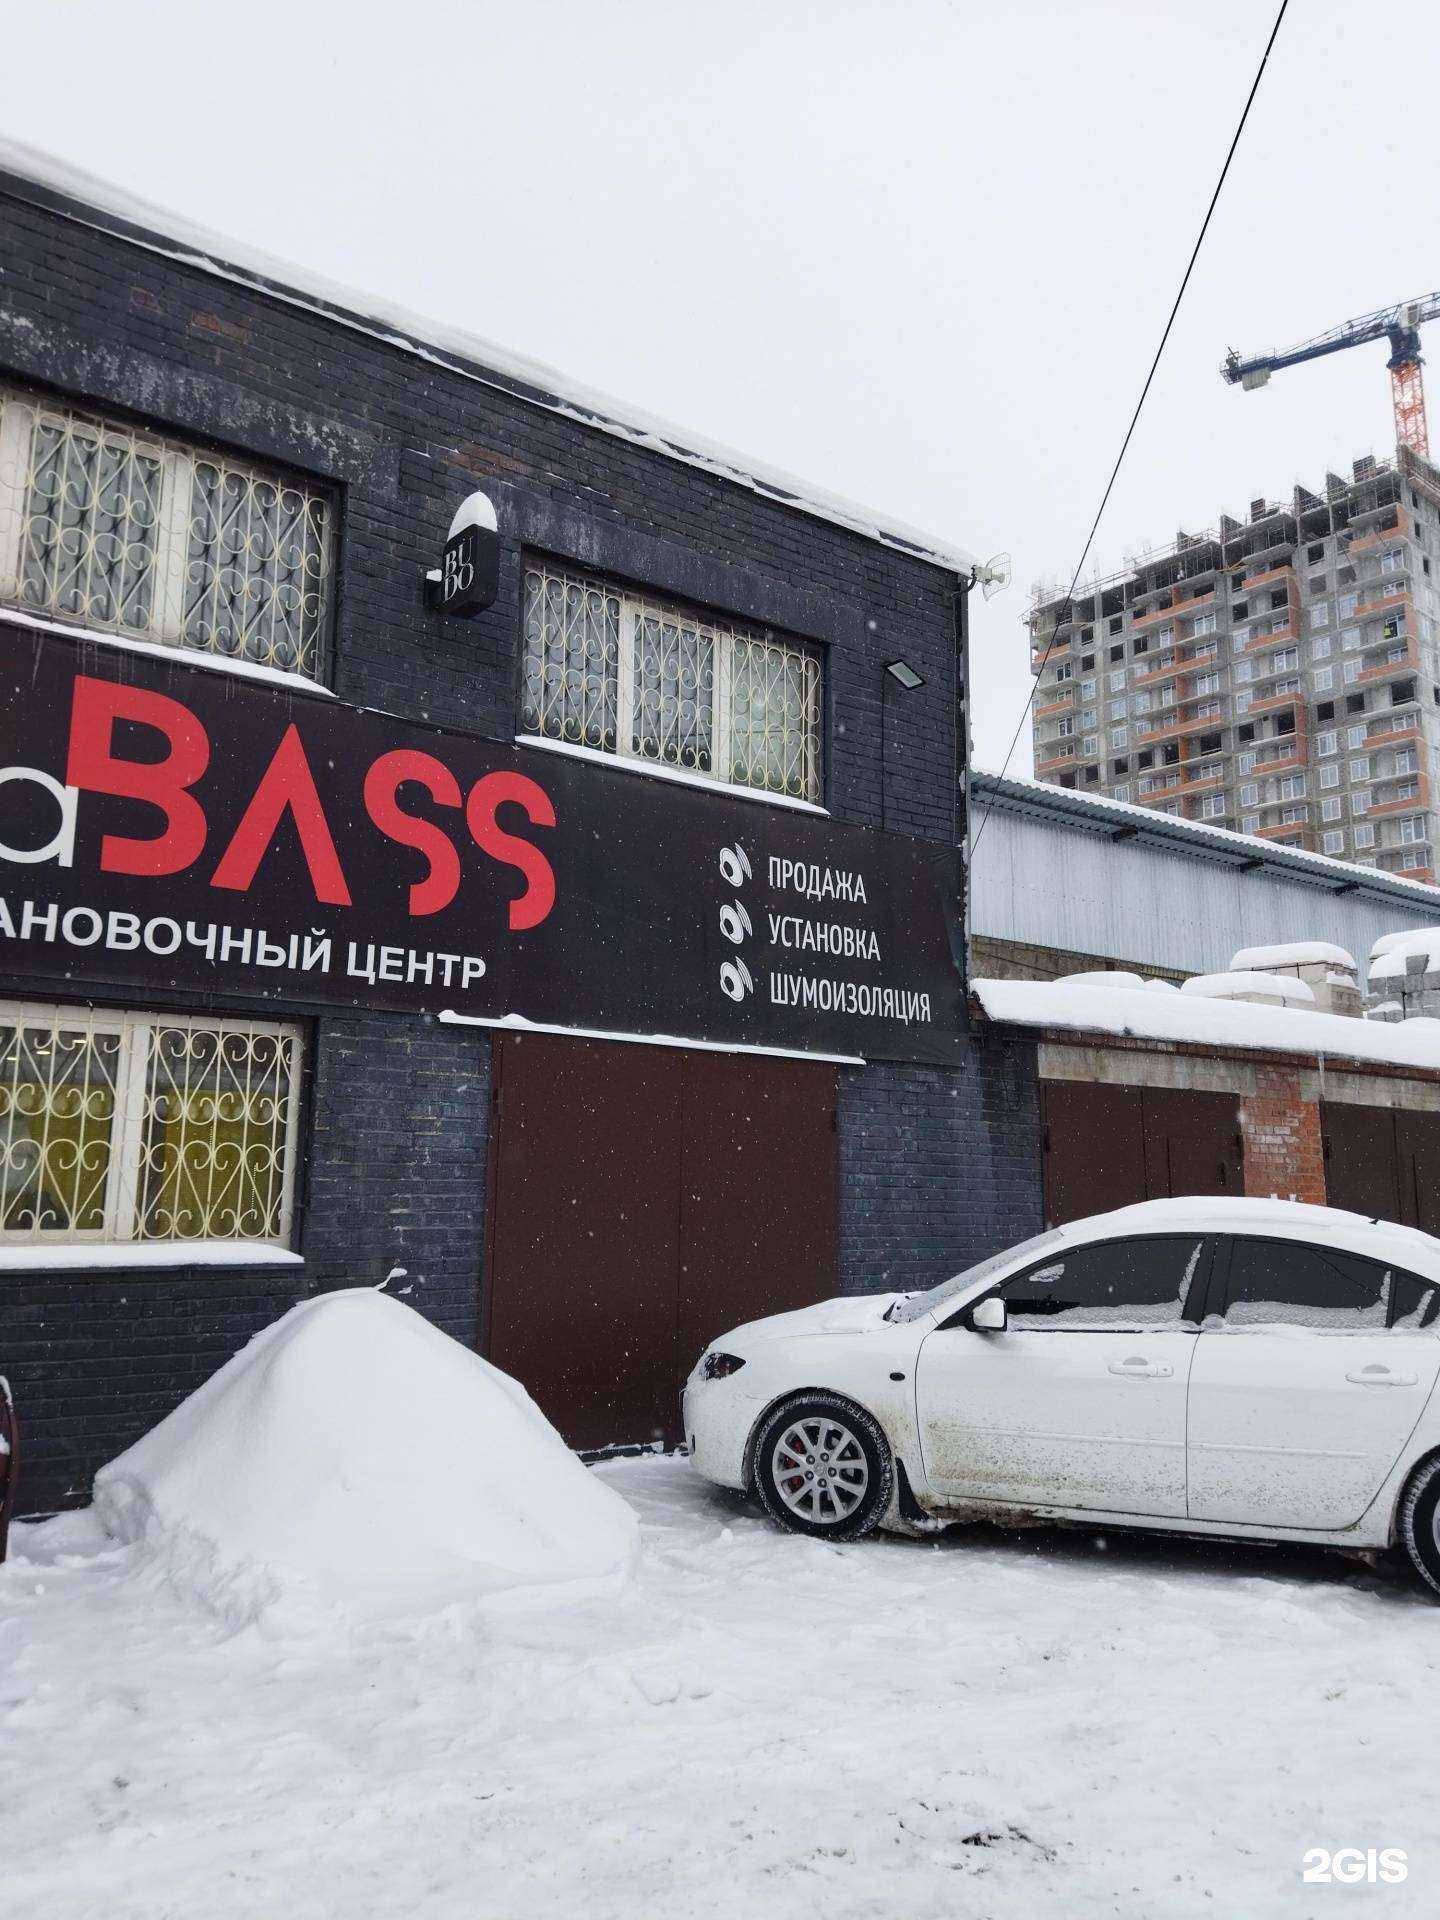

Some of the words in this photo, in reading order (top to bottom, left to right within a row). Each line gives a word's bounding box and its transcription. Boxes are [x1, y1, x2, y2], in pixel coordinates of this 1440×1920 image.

[445, 535, 474, 578] BU
[442, 562, 475, 603] DO
[769, 856, 867, 904] ПРОДАЖА
[768, 913, 882, 962] УСТАНОВКА
[346, 941, 487, 989] ЦЕНТР
[769, 972, 931, 1026] ШУМОИЗОЛЯЦИЯ
